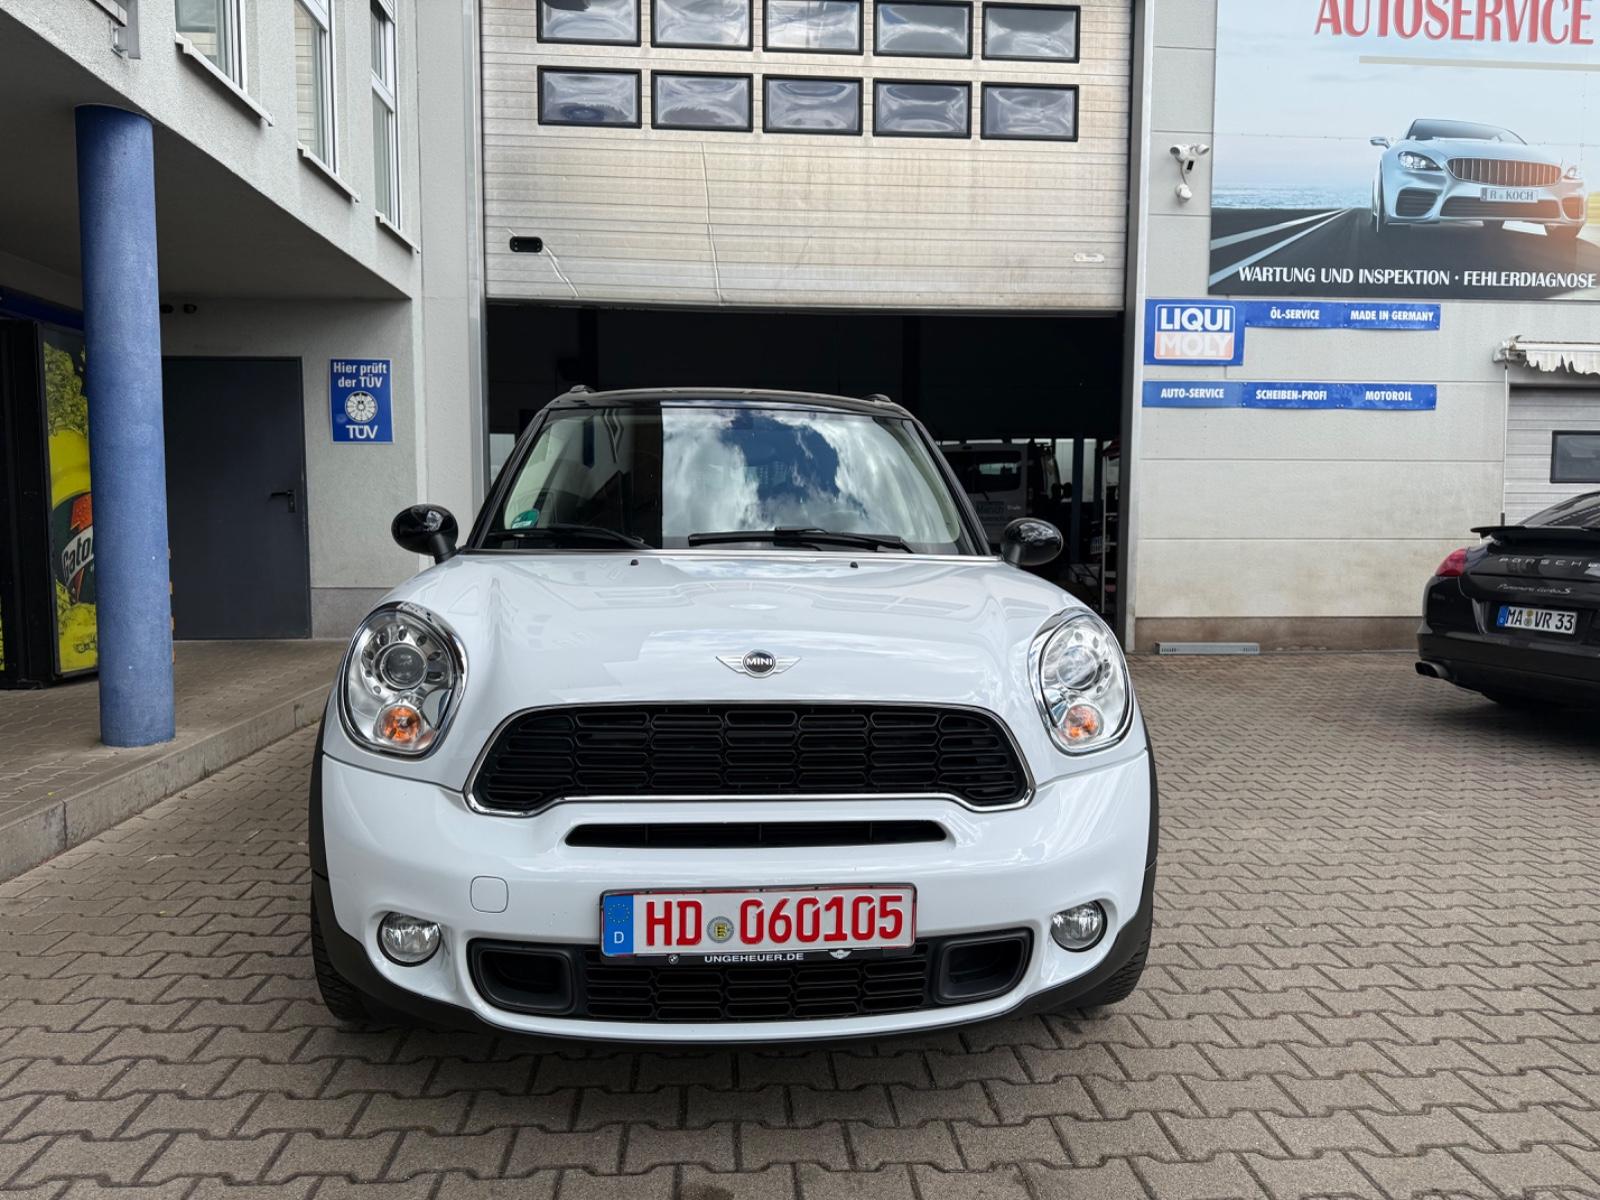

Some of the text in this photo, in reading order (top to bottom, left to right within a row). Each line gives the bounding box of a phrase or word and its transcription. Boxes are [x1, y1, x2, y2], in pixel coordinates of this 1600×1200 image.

[1314, 0, 1594, 44] AUTOSERVICE
[1506, 190, 1534, 200] KOCH
[1238, 266, 1597, 288] WARTUNG UND INSPEKTION FEHLERDIAGNOSE
[1160, 307, 1231, 332] LIQUI
[1270, 306, 1320, 320] ÖL-SERVICE
[1350, 310, 1434, 322] MADE IN GERMANY
[1160, 334, 1233, 356] MOLY
[333, 362, 388, 376] Hier prüft
[337, 374, 383, 388] der TÜV
[1161, 388, 1225, 399] AUTO-SERVICE
[1256, 389, 1328, 401] SCHEIBEN-PROFI
[1365, 390, 1413, 401] MOTOROIL
[346, 425, 379, 439] TÜV
[1506, 608, 1575, 631] MA VR 33
[746, 658, 773, 666] MINI
[646, 894, 903, 946] HD 060105
[613, 931, 625, 944] D
[704, 952, 804, 963] UNGEHEUER.DE
